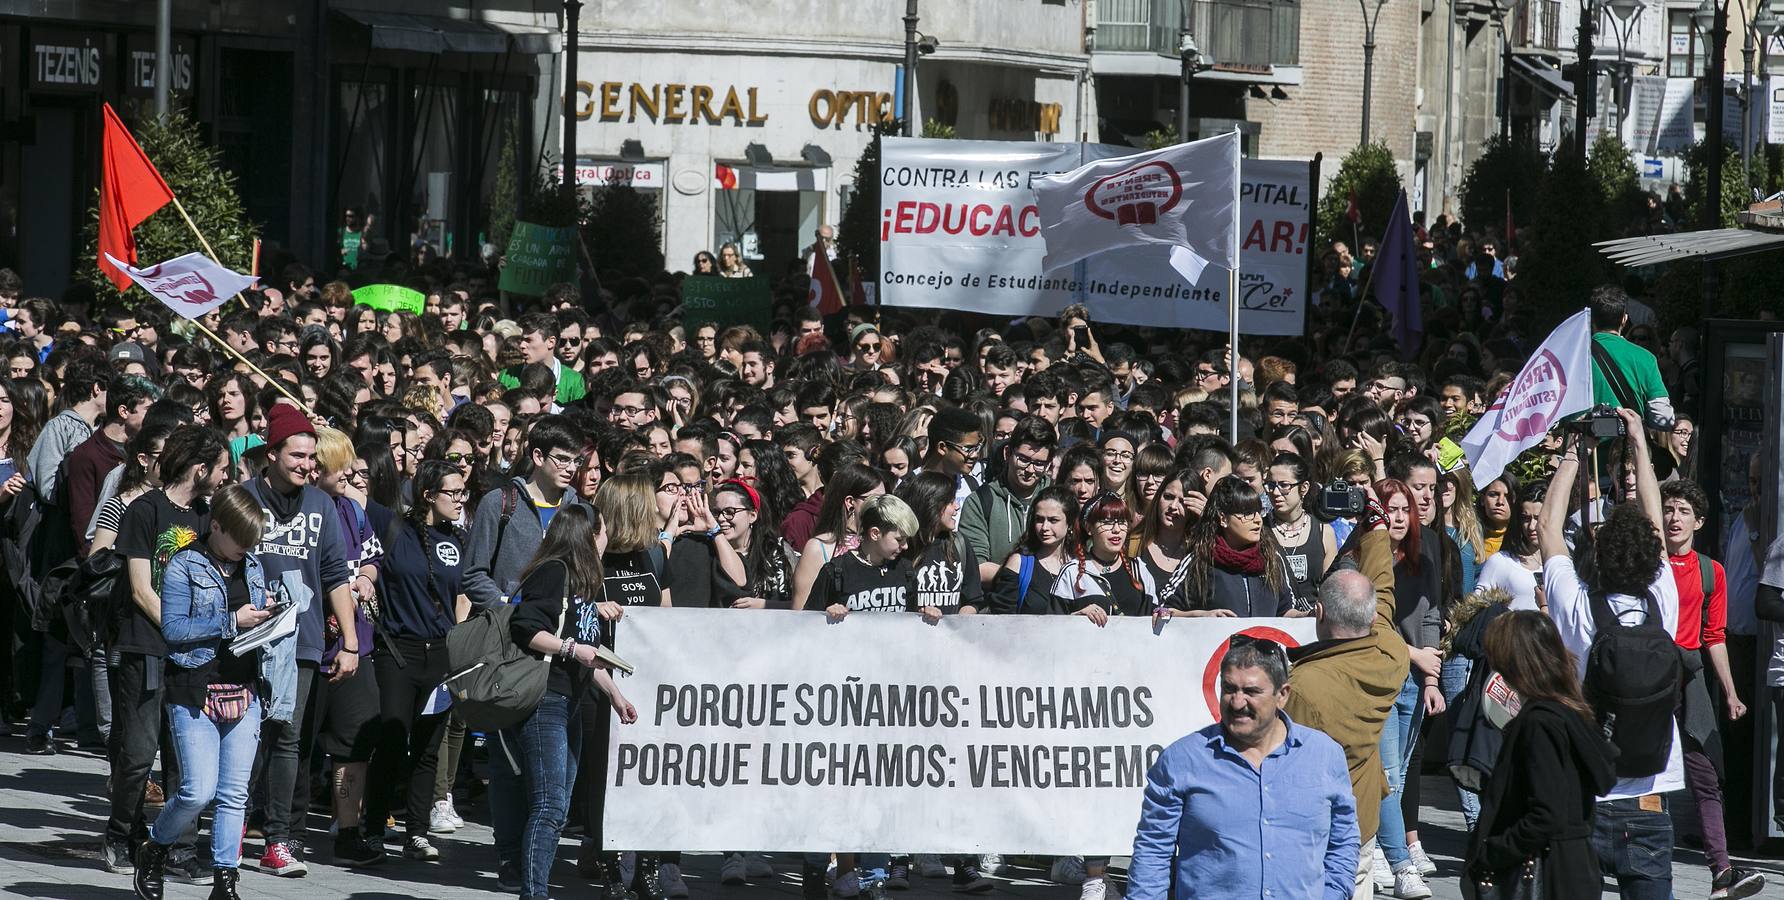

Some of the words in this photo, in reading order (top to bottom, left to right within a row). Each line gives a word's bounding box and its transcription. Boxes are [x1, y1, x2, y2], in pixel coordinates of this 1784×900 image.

[35, 39, 100, 85] TEZENIS
[132, 46, 191, 89] TEZNIS
[563, 81, 768, 125] GENERAL
[883, 167, 969, 188] CONTRA
[979, 169, 1020, 189] LAS
[1240, 183, 1308, 210] PITAL,
[881, 201, 1041, 241] ¡EDUCAC
[1242, 219, 1308, 254] AR!
[884, 271, 953, 289] Concejo
[961, 273, 980, 287] de
[1090, 279, 1220, 302] Independiente
[263, 544, 280, 553] NEW
[282, 546, 301, 556] YORK
[621, 582, 646, 591] 30%
[847, 586, 907, 611] ARCTIC
[917, 592, 961, 607] VOLUTIO
[654, 683, 789, 729] PORQUE
[793, 676, 970, 728] SOÑAMOS:
[979, 685, 1154, 729] LUCHAMOS
[615, 742, 752, 788] PORQUE
[761, 741, 956, 788] LUCHAMOS:
[967, 743, 1165, 789] VENCEREMO
